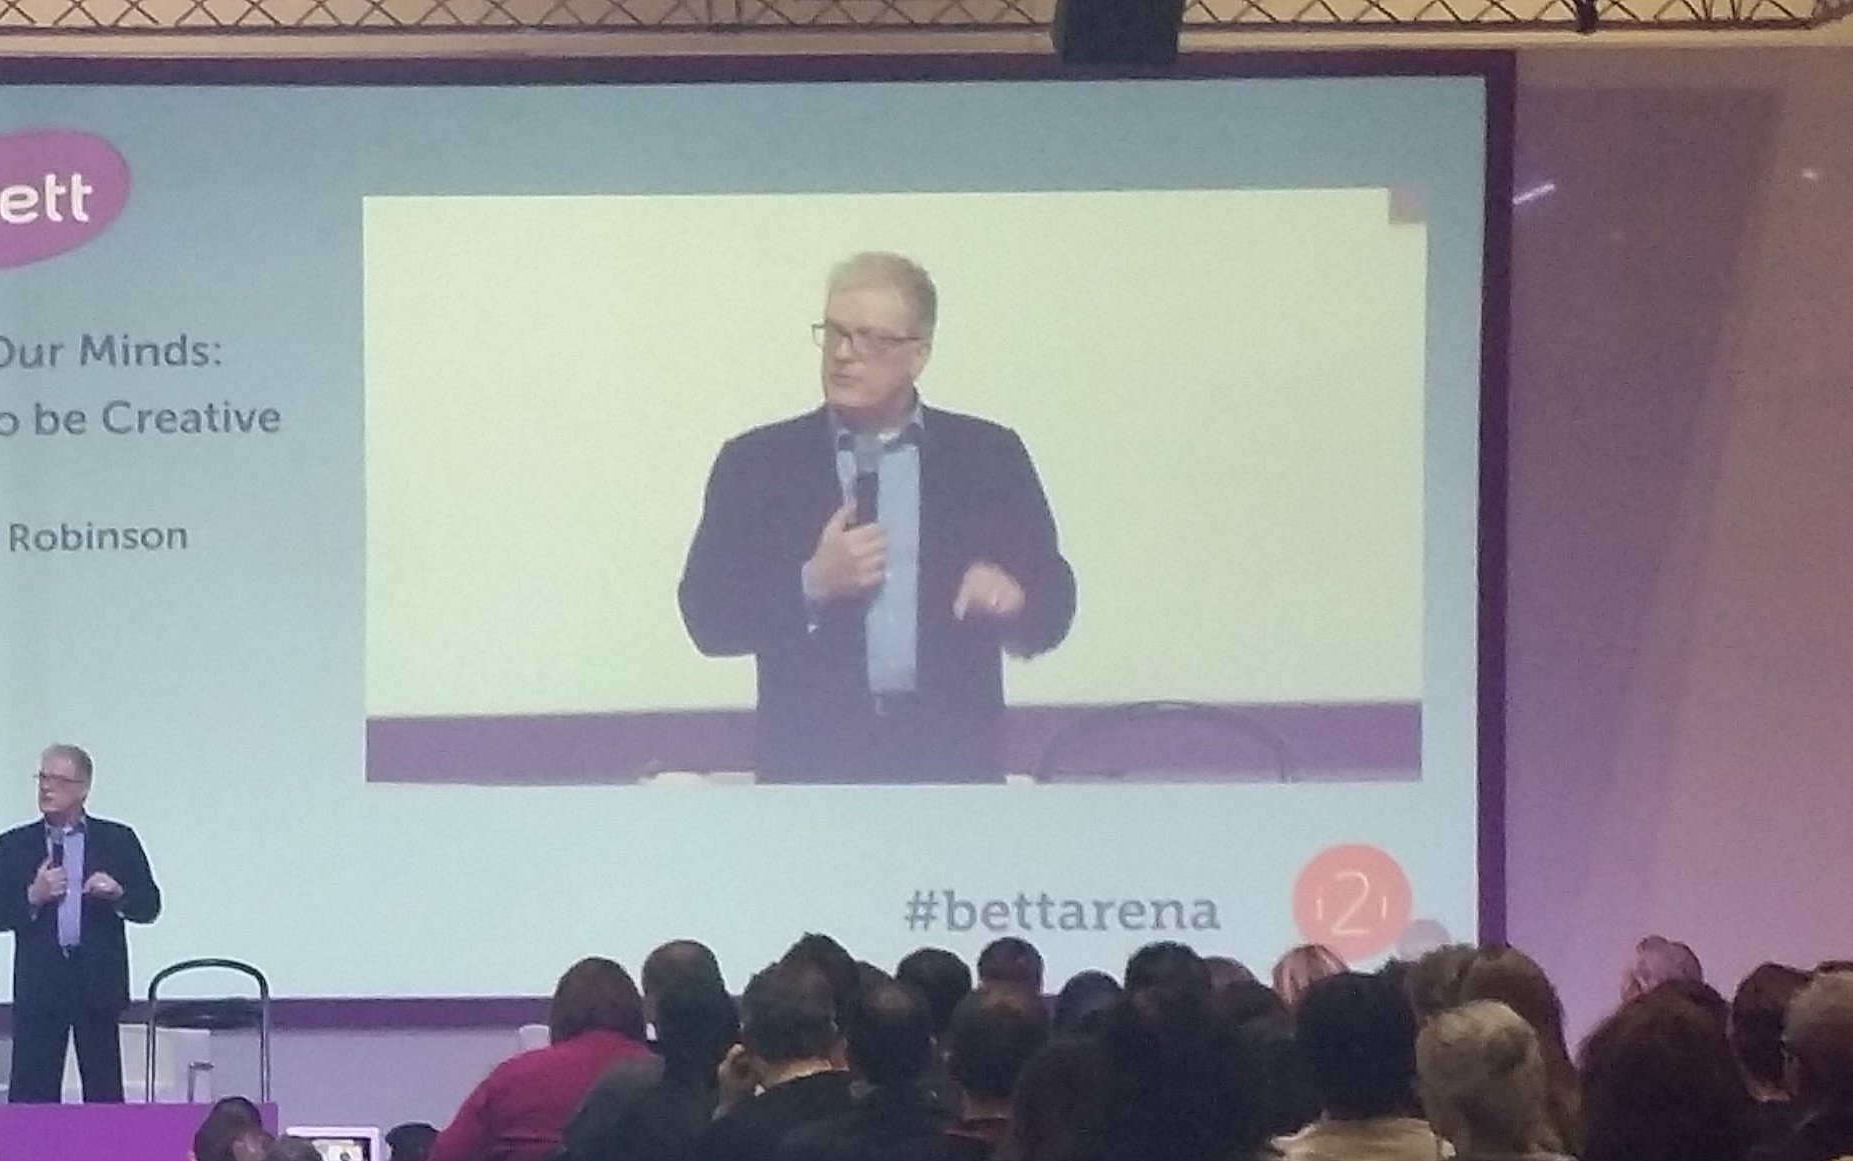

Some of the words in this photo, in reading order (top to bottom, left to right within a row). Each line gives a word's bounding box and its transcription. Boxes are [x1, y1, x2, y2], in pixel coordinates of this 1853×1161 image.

[79, 332, 223, 369] Minds:
[34, 401, 87, 437] be
[101, 398, 282, 436] Creative
[8, 520, 189, 554] Robinson
[902, 888, 1223, 932] #bettarena
